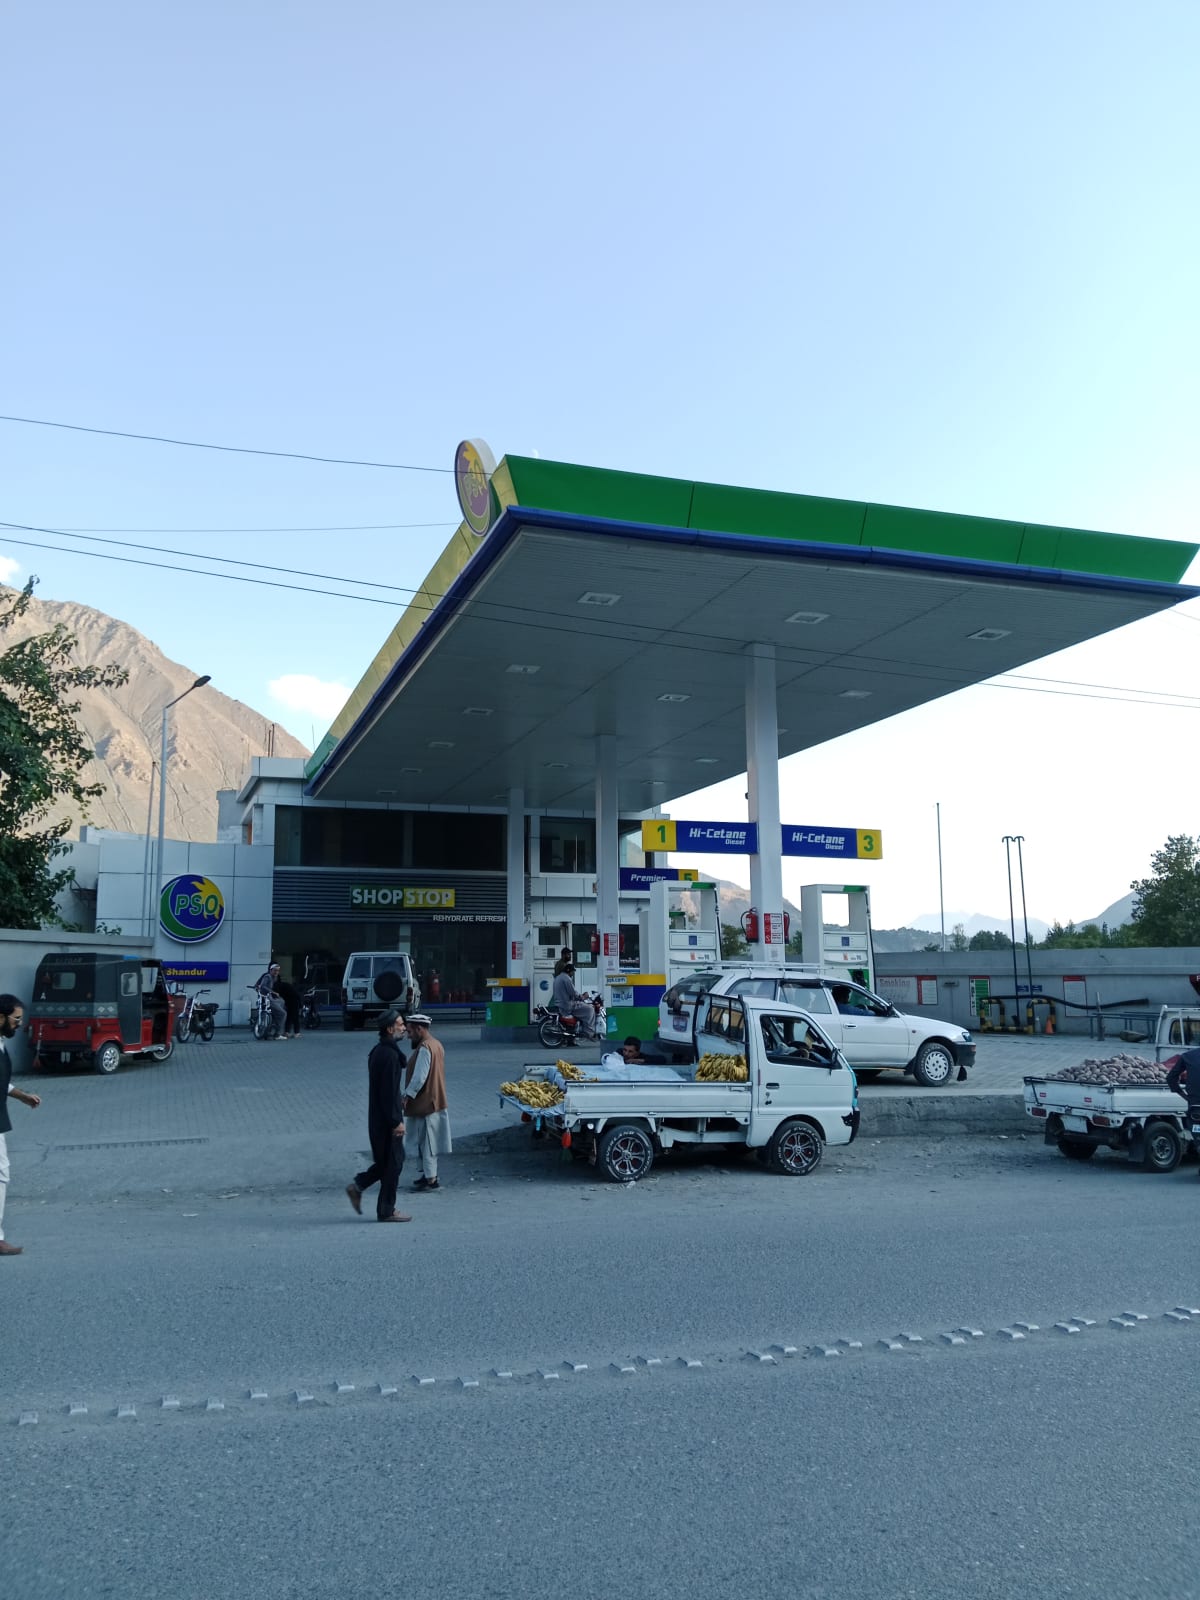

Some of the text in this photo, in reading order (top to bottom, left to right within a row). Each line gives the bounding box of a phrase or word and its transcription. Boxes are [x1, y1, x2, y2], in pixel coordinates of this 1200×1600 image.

[657, 825, 667, 843] 1
[689, 827, 747, 839] Hi-Cetane
[791, 832, 845, 844] Hi-Cetane
[863, 834, 875, 852] 3
[630, 873, 667, 882] Premier
[352, 888, 453, 905] SHOP STOP
[175, 893, 219, 915] PSO
[432, 914, 507, 922] REHYDRATE REFRESH
[166, 968, 207, 976] Shandur
